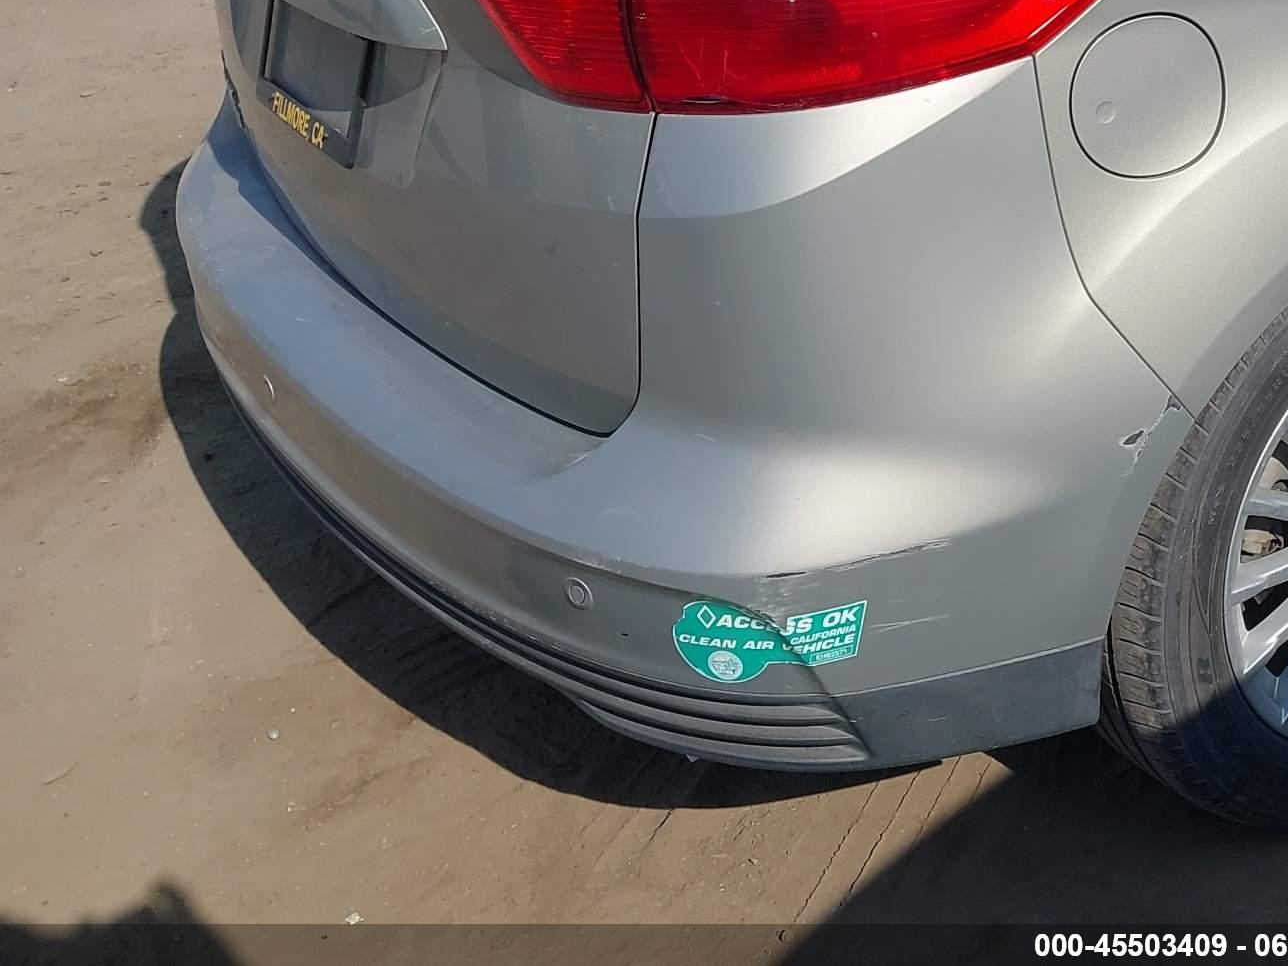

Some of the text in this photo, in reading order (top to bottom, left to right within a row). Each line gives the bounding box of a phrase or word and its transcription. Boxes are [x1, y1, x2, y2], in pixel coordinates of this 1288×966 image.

[311, 121, 325, 149] CA
[823, 606, 859, 627] OK
[679, 633, 856, 654] CLEAN AIR VEHICLE
[790, 624, 856, 645] CALIFORNIA
